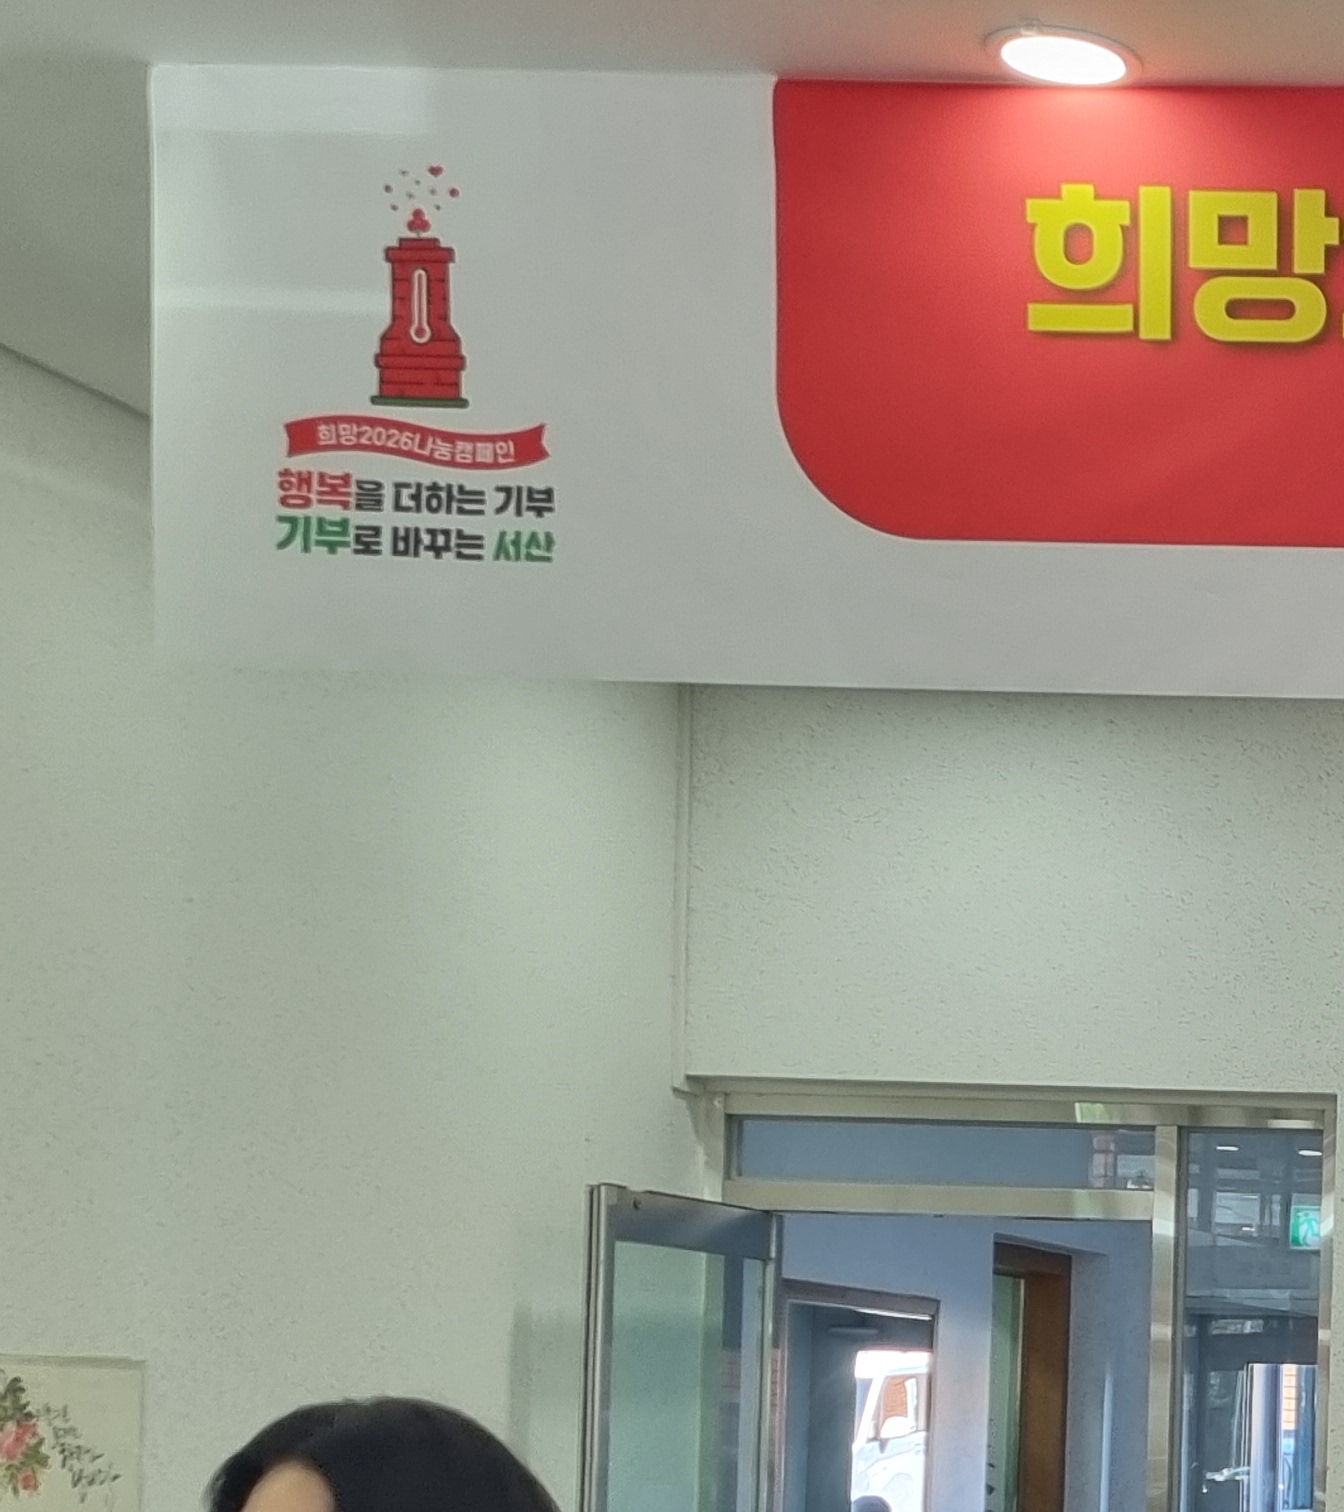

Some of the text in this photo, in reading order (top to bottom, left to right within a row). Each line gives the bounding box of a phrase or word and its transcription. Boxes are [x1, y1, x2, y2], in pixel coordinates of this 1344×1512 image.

[317, 422, 515, 463] 희망2026나눔캠페인
[277, 468, 555, 519] 행복을 더하는 기부
[276, 515, 556, 564] 기부로 바꾸는 서산
